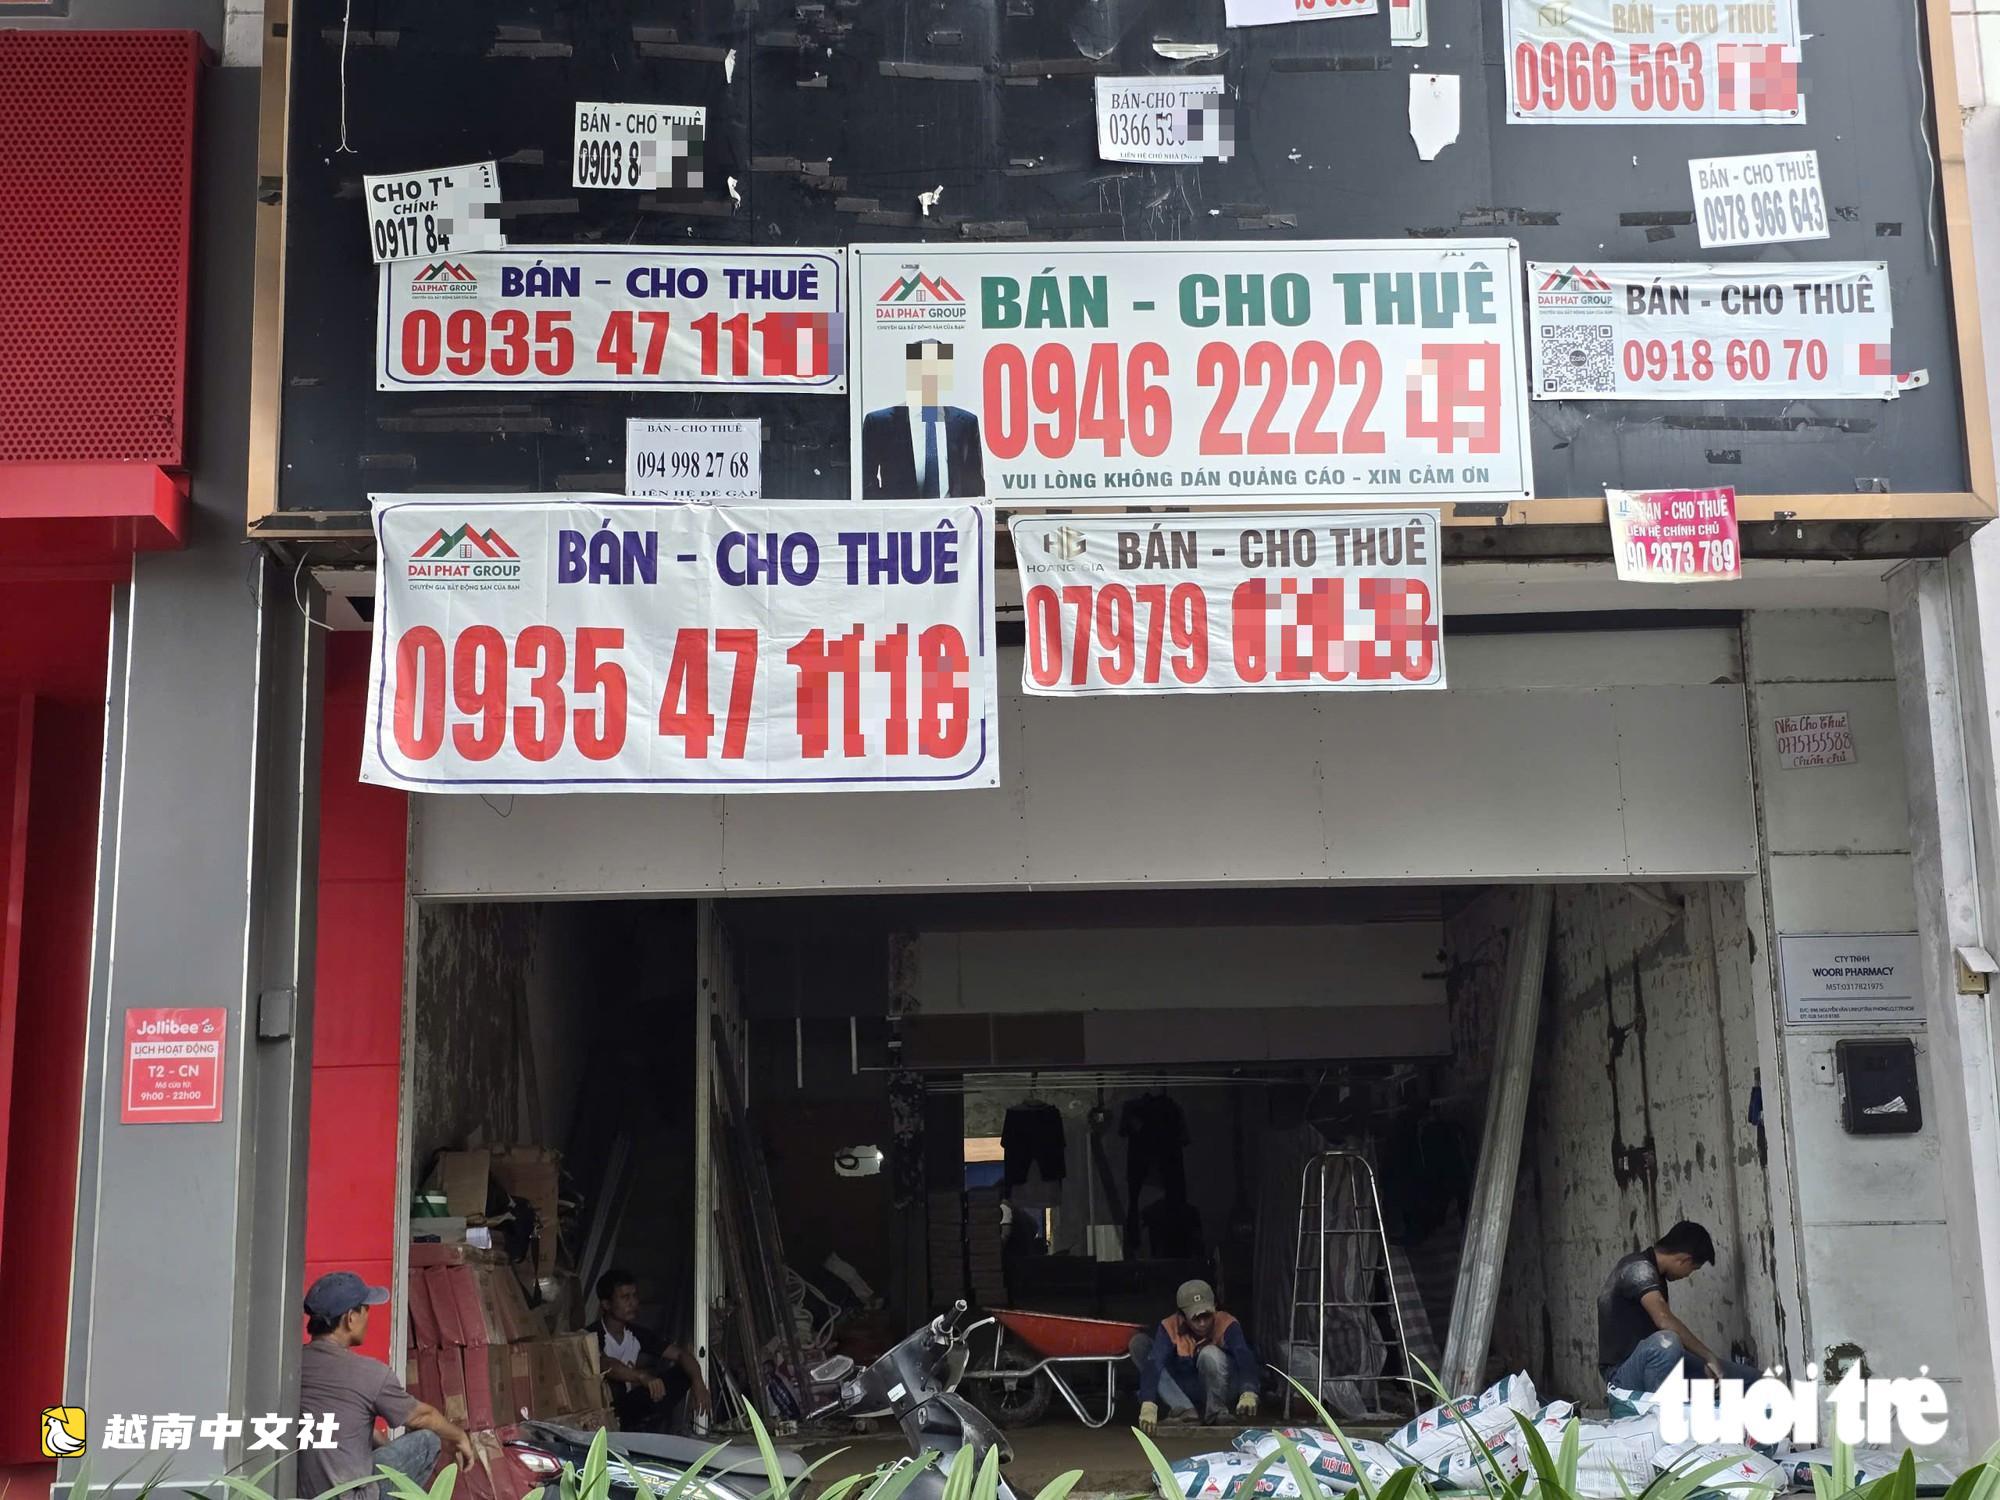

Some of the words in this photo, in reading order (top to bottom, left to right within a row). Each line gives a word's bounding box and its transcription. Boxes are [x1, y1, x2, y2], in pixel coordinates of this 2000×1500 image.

[1612, 0, 1655, 34] BÁN
[1675, 4, 1719, 34] CHO
[1727, 1, 1778, 34] THUÊ
[1515, 41, 1617, 111] 0966
[1629, 41, 1705, 111] 563
[580, 106, 611, 133] BÁN
[626, 114, 657, 134] CHO
[1109, 113, 1151, 146] 0366
[578, 139, 622, 186] 0903
[1698, 162, 1730, 190] BÁN
[1743, 163, 1774, 186] CHO
[1776, 153, 1816, 183] THUÊ
[372, 180, 422, 203] CHO
[1703, 193, 1750, 242] 0978
[1751, 189, 1787, 238] 966
[1789, 186, 1824, 234] 643
[375, 215, 418, 259] 0917
[411, 284, 426, 292] DAI
[426, 284, 448, 292] PHAT
[449, 284, 478, 292] GROUP
[501, 260, 581, 298] BÁN
[626, 267, 709, 298] CHO
[722, 263, 819, 300] THUÊ
[981, 266, 1109, 329] BÁN
[1178, 273, 1311, 328] CHO
[1332, 261, 1497, 329] THUÊ
[1626, 276, 1690, 316] BÁN
[1720, 284, 1784, 316] CHO
[1792, 274, 1876, 315] THUÊ
[876, 308, 894, 319] DAI
[897, 308, 926, 318] PHAT
[928, 307, 967, 318] GROUP
[1537, 295, 1554, 305] DAI
[1555, 295, 1579, 305] PHAT
[1580, 295, 1613, 304] GROUP
[401, 309, 574, 376] 0935
[596, 310, 670, 376] 47
[1623, 339, 1714, 382] 0918
[1726, 339, 1770, 382] 60
[1783, 338, 1828, 381] 70
[983, 341, 1172, 459] 0946
[1196, 340, 1386, 455] 2222
[647, 422, 672, 433] BÁN
[681, 424, 708, 433] CHO
[710, 422, 743, 433] THUÊ
[636, 451, 666, 478] 094
[671, 451, 700, 478] 998
[705, 451, 725, 478] 27
[730, 451, 749, 478] 68
[1002, 473, 1037, 489] VUI
[1044, 469, 1096, 489] LÒNG
[1104, 468, 1173, 488] KHÔNG
[1180, 467, 1221, 486] DÁN
[1228, 466, 1298, 488] QUẢNG
[1304, 466, 1346, 485] CÁO
[1368, 468, 1401, 485] XIN
[1409, 465, 1454, 484] CẢM
[1461, 465, 1489, 483] ƠN
[631, 488, 669, 497] LIÊN
[1671, 501, 1695, 520] CHO
[1697, 494, 1729, 518] THUÊ
[1118, 522, 1198, 570] BÁN
[1240, 528, 1317, 569] CHO
[1329, 518, 1427, 567] THUÊ
[1648, 523, 1661, 539] HỆ
[1663, 522, 1696, 537] CHÍNH
[1698, 521, 1720, 535] CHỦ
[558, 518, 658, 585] BÁN
[716, 531, 820, 586] CHO
[838, 518, 959, 585] THUÊ
[1651, 540, 1696, 575] 2873
[1698, 538, 1736, 573] 789
[407, 564, 431, 577] DAI
[434, 564, 471, 577] PHAT
[472, 564, 521, 577] GROUP
[1026, 581, 1209, 686] 07979
[393, 625, 628, 762] 0935
[658, 628, 758, 760] 47
[1812, 968, 1843, 977] WOORI
[1845, 966, 1894, 977] PHARMACY
[1834, 955, 1848, 963] CTY
[1850, 955, 1871, 963] TNHH
[136, 1018, 199, 1035] Jollibee
[134, 1045, 156, 1057] LỊCH
[158, 1044, 184, 1056] HOẠT
[186, 1042, 215, 1055] ĐỘNG
[147, 1065, 165, 1078] T2
[178, 1064, 200, 1077] CN
[140, 1092, 164, 1101] 9h00
[172, 1091, 201, 1100] 22h00
